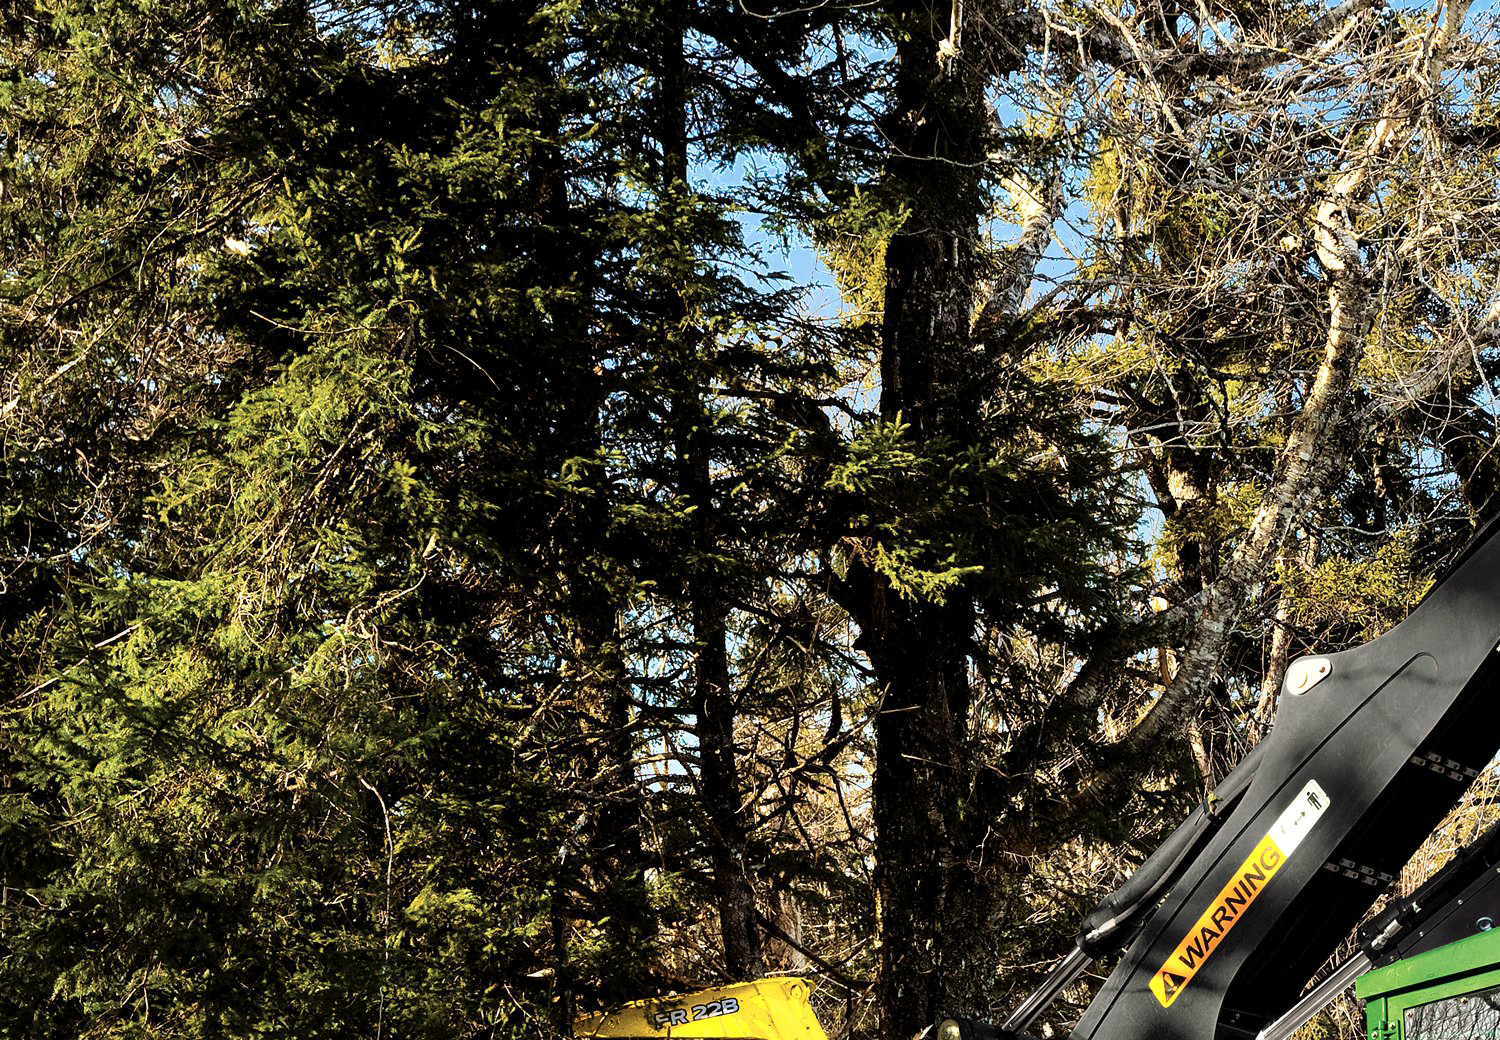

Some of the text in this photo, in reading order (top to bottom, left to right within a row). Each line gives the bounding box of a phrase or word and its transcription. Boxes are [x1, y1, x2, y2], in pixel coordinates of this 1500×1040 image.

[1178, 846, 1281, 970] WARNING
[654, 998, 739, 1031] FR 22B
